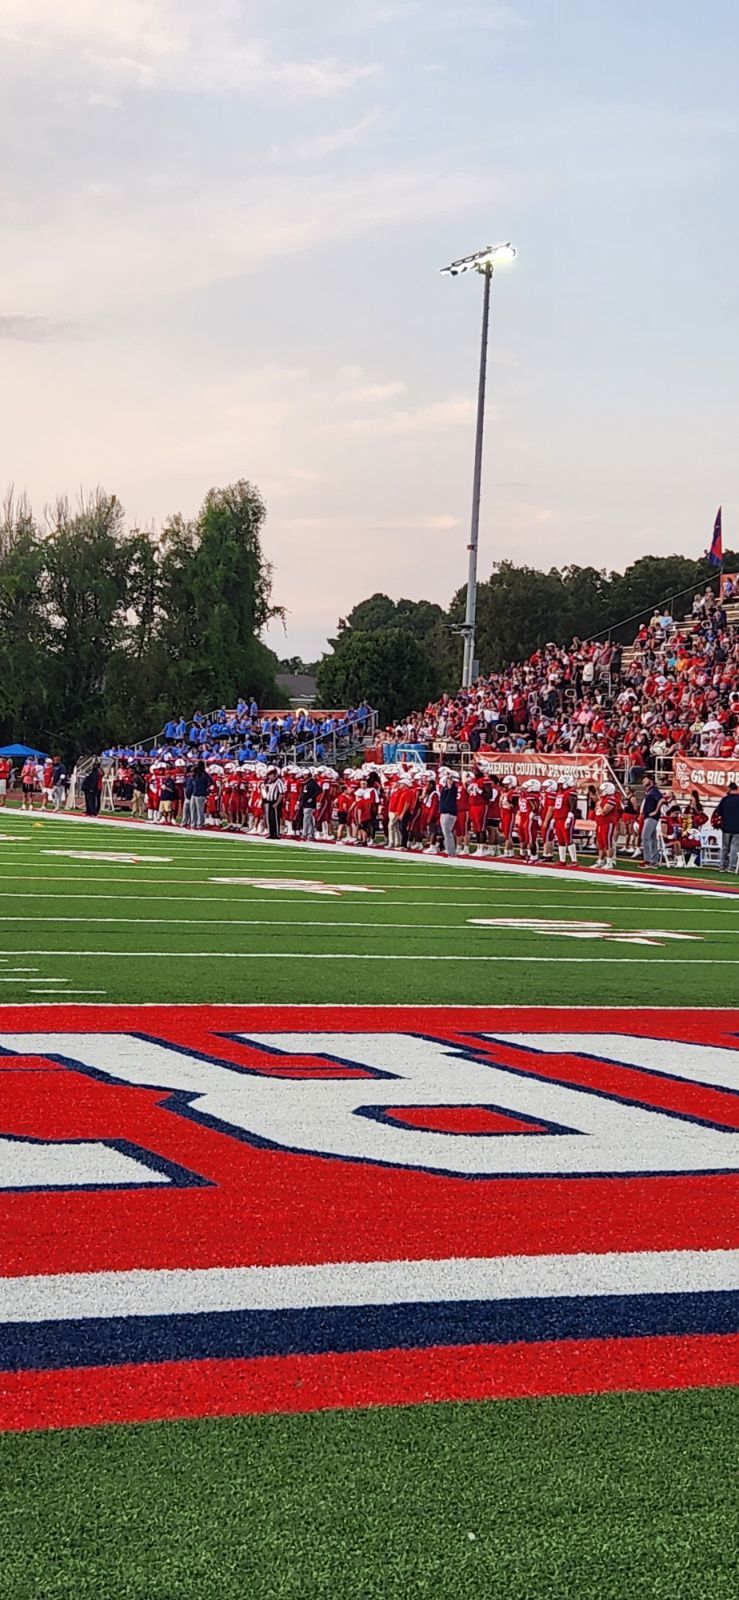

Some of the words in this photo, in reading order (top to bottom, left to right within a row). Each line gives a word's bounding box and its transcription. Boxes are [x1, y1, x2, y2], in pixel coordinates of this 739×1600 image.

[488, 761, 513, 774] HENRY
[515, 763, 546, 776] COUNTY
[548, 764, 591, 779] PATRIOTS
[691, 770, 706, 784] GO
[707, 770, 726, 786] BIG
